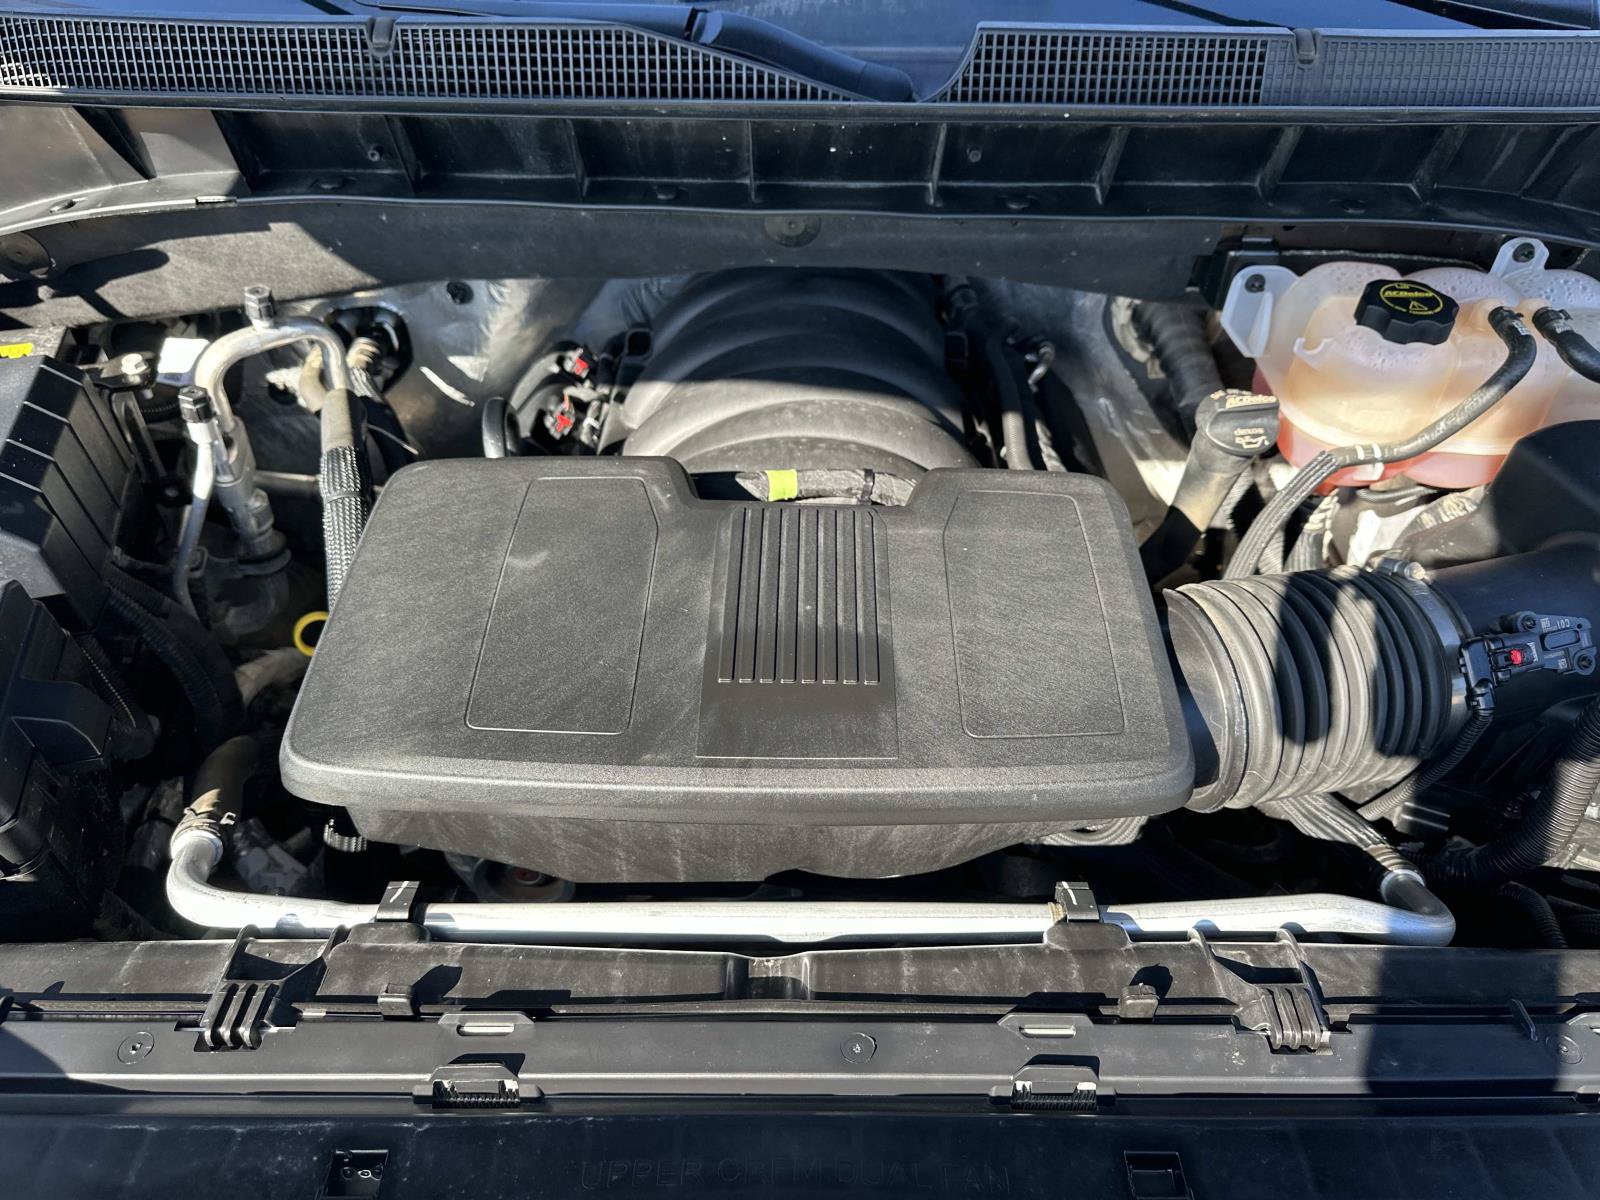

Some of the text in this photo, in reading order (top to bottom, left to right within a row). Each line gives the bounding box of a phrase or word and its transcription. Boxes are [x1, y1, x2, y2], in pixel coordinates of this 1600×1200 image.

[1384, 290, 1434, 298] ACDelco
[1226, 395, 1277, 409] ACDelco
[581, 1158, 705, 1190] UPPER
[836, 1158, 936, 1190] DUAL
[942, 1160, 1010, 1193] FAN
